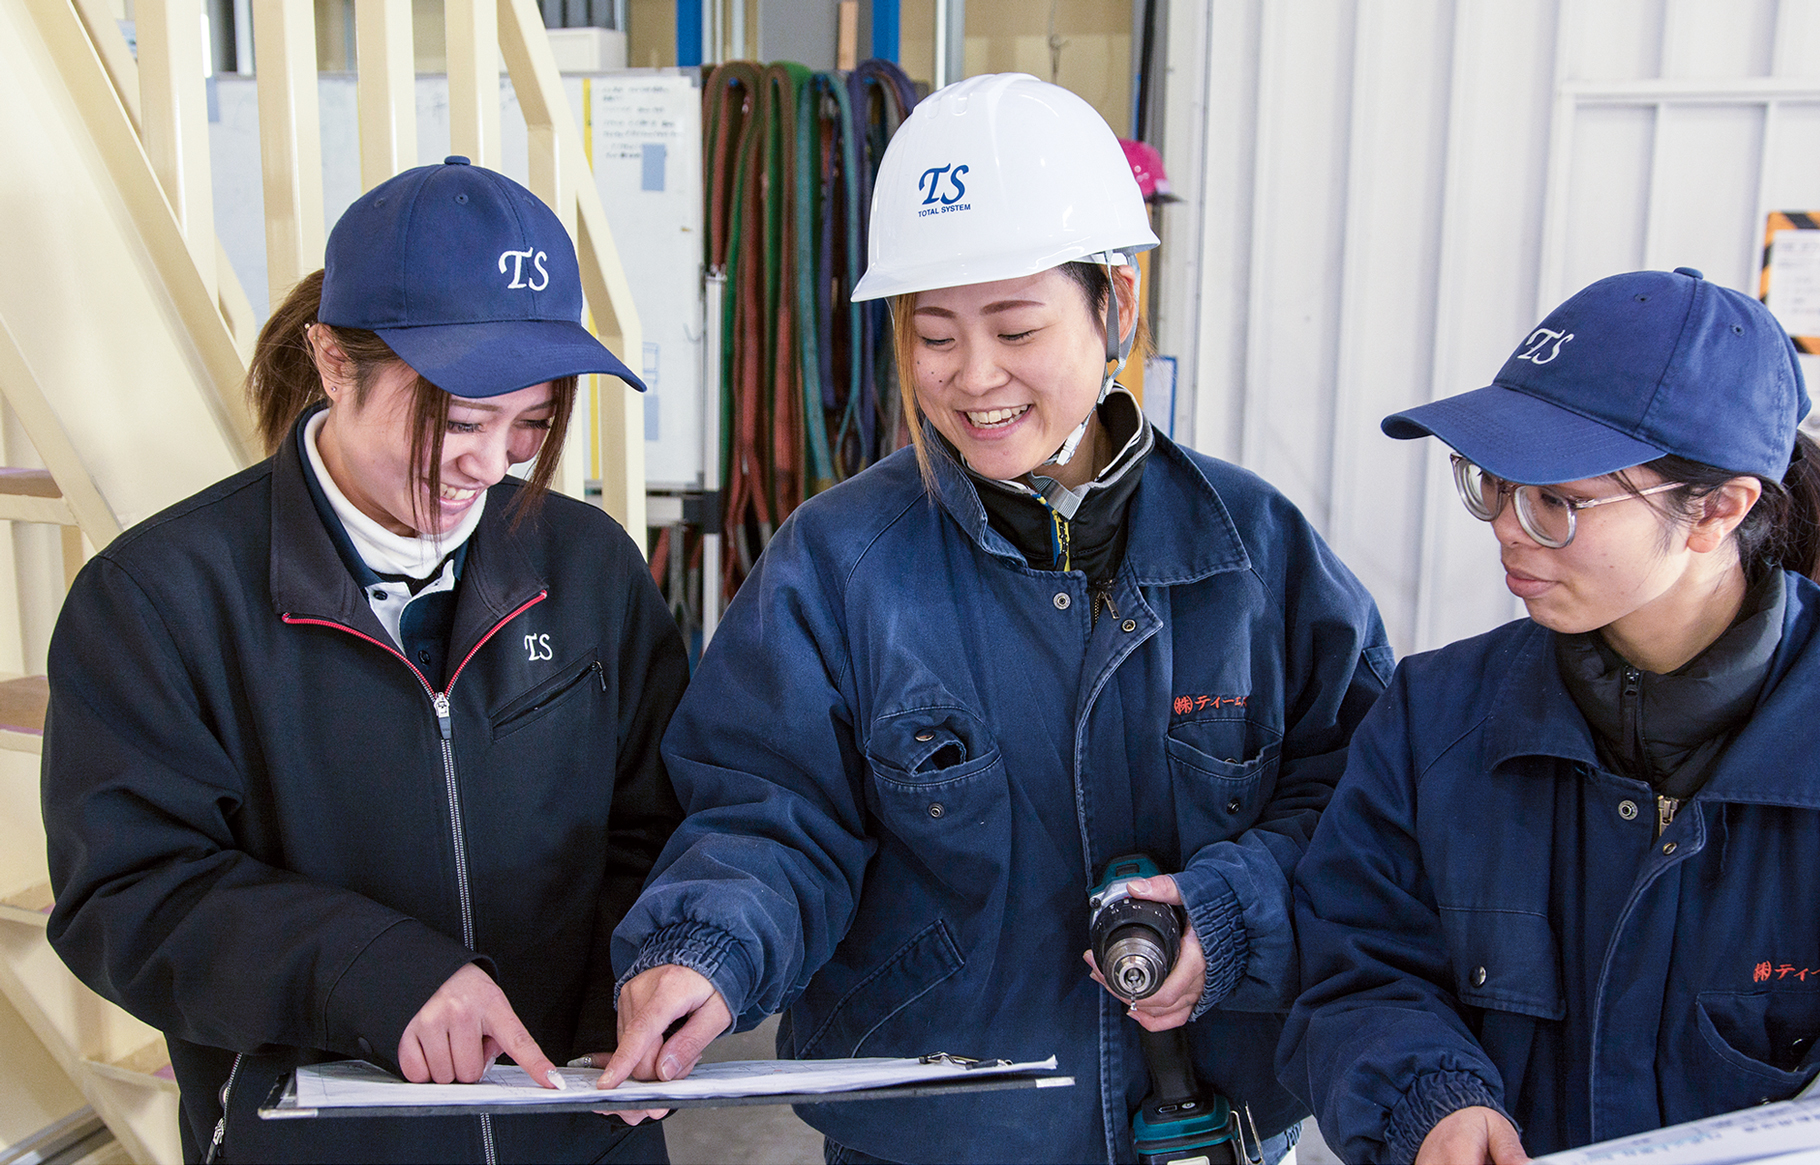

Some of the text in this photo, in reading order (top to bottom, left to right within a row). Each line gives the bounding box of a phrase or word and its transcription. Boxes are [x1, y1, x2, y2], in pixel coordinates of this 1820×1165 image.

[918, 162, 969, 205] TS
[918, 203, 971, 217] TOTAL SYSTEM
[498, 246, 549, 291] TS
[1517, 327, 1575, 365] TS
[523, 632, 553, 661] TS
